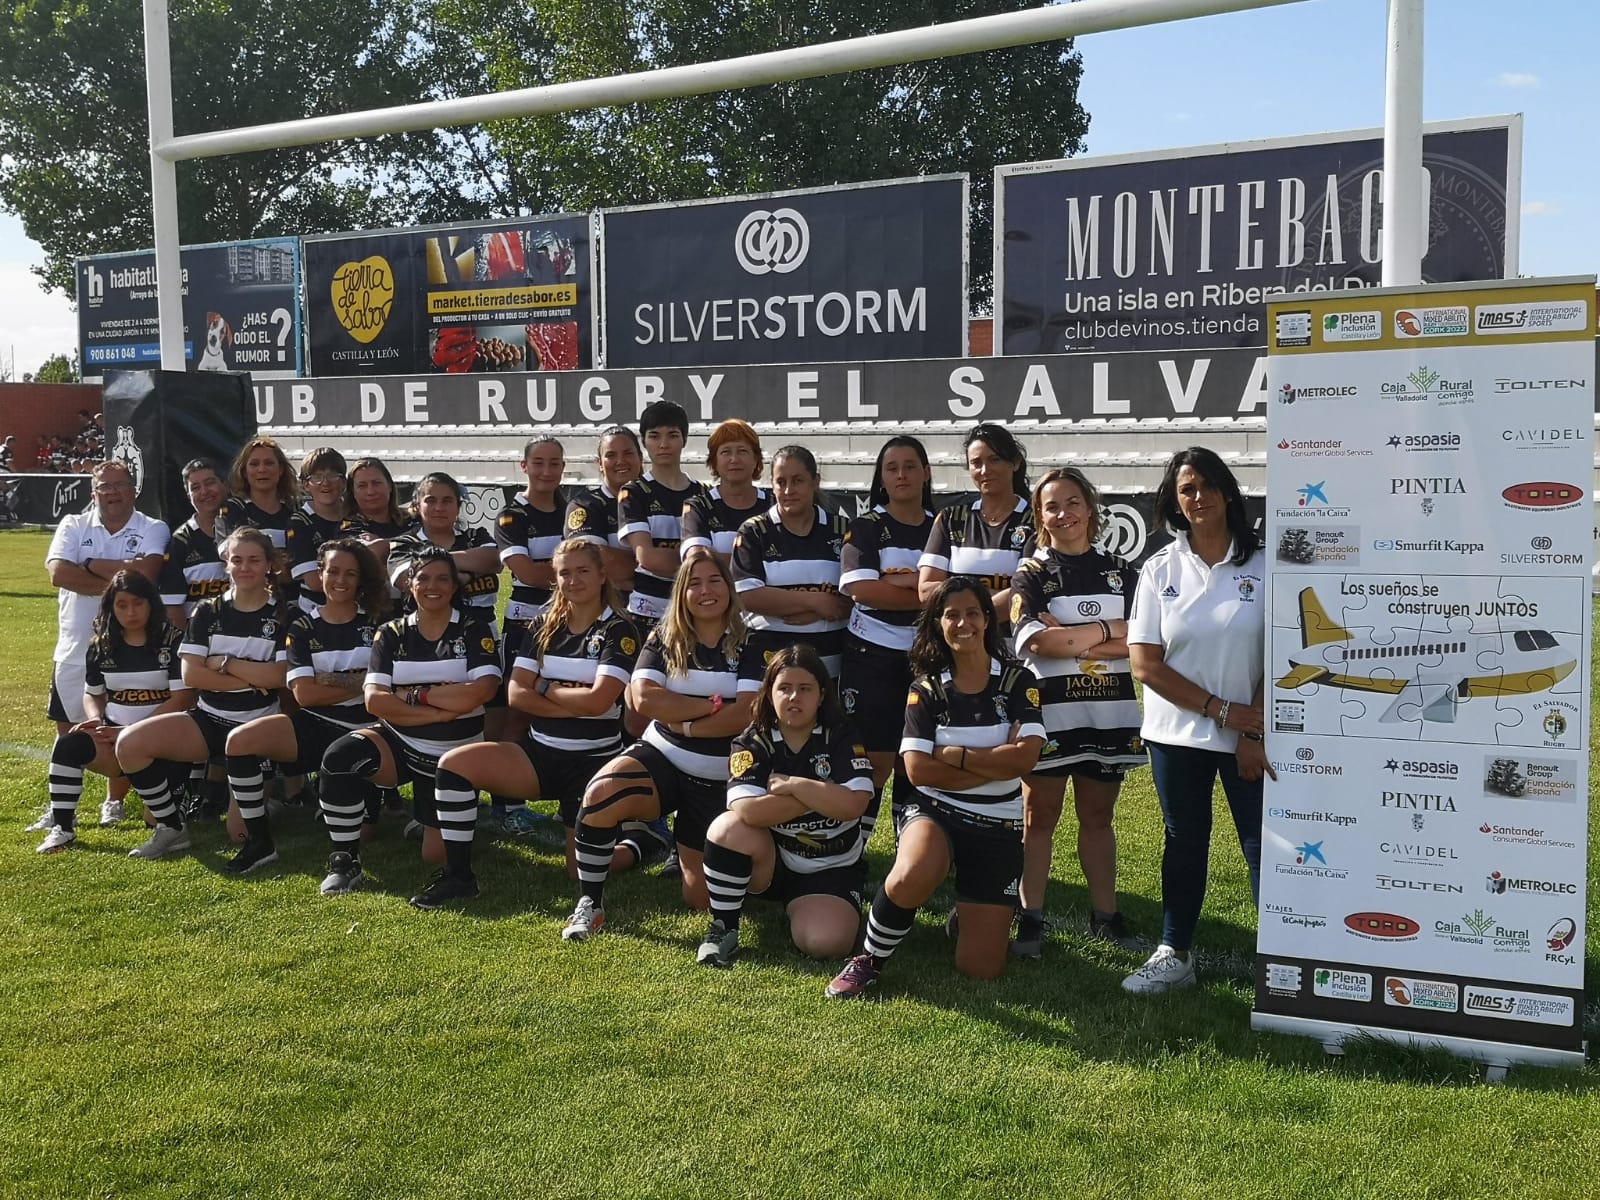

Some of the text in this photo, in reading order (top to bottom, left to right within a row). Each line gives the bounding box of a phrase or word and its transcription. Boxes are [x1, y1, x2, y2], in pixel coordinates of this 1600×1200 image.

[339, 291, 356, 307] de
[433, 291, 571, 309] market.tierradesabor.es
[1065, 293, 1111, 314] Una
[1118, 287, 1158, 311] isla
[1164, 290, 1194, 308] en
[343, 299, 392, 330] sabor
[634, 287, 926, 344] SILVERSTORM
[1530, 307, 1582, 315] INTERNATIONAL
[242, 312, 267, 328] ¿HAS
[1341, 314, 1376, 324] Plena
[1065, 314, 1260, 340] clubdevinos.tienda
[1341, 324, 1376, 332] inclusión
[234, 331, 271, 344] OÍDO EL
[271, 308, 292, 362] ?
[90, 350, 104, 360] 900
[105, 349, 119, 360] 861
[121, 347, 136, 359] 048
[236, 350, 270, 363] RUMOR
[332, 347, 400, 360] CASTILLA Y LEÓN
[361, 380, 430, 421] DE
[787, 370, 879, 419] EL
[947, 359, 1268, 419] SALVA
[1382, 380, 1472, 394] Caja Rural
[1496, 379, 1585, 391] TOLTEN
[1298, 386, 1357, 398] METROLEC
[1405, 432, 1461, 447] aspasia
[1502, 429, 1585, 441] CAVIDEL
[1291, 440, 1342, 449] Santander
[1390, 478, 1466, 494] PINTIA
[1514, 490, 1570, 499] TORO
[1276, 509, 1315, 518] Fundación
[1395, 540, 1484, 554] Smurfit Kappa
[1316, 553, 1346, 561] España
[1501, 553, 1583, 564] SILVERSTORM
[1341, 581, 1439, 596] Los sueños se
[1388, 602, 1538, 618] construyen JUNTOS
[1544, 700, 1578, 712] SALVADOR
[1271, 760, 1342, 775] SILVERSTORM
[1402, 760, 1458, 775] aspasia
[1527, 763, 1559, 772] Renault
[1527, 771, 1553, 779] Group
[1527, 780, 1575, 789] Fundación
[1527, 788, 1561, 796] España
[1380, 792, 1459, 812] PINTIA
[1285, 809, 1357, 826] Smurfit Kappa
[1493, 825, 1544, 838] Santander
[1492, 836, 1575, 849] Consumer Global Services
[1380, 842, 1458, 859] CAVIDEL
[1275, 865, 1313, 876] Fundación
[1376, 876, 1463, 893] TOLTEN
[1508, 879, 1577, 894] METROLEC
[1266, 904, 1293, 913] VIAJES
[1356, 918, 1408, 931] TORO
[1435, 920, 1528, 939] Caja Rural
[1450, 935, 1483, 945] Valladolid
[1545, 953, 1576, 965] FRCyL
[1332, 972, 1366, 985] Plena
[1332, 984, 1366, 993] inclusión
